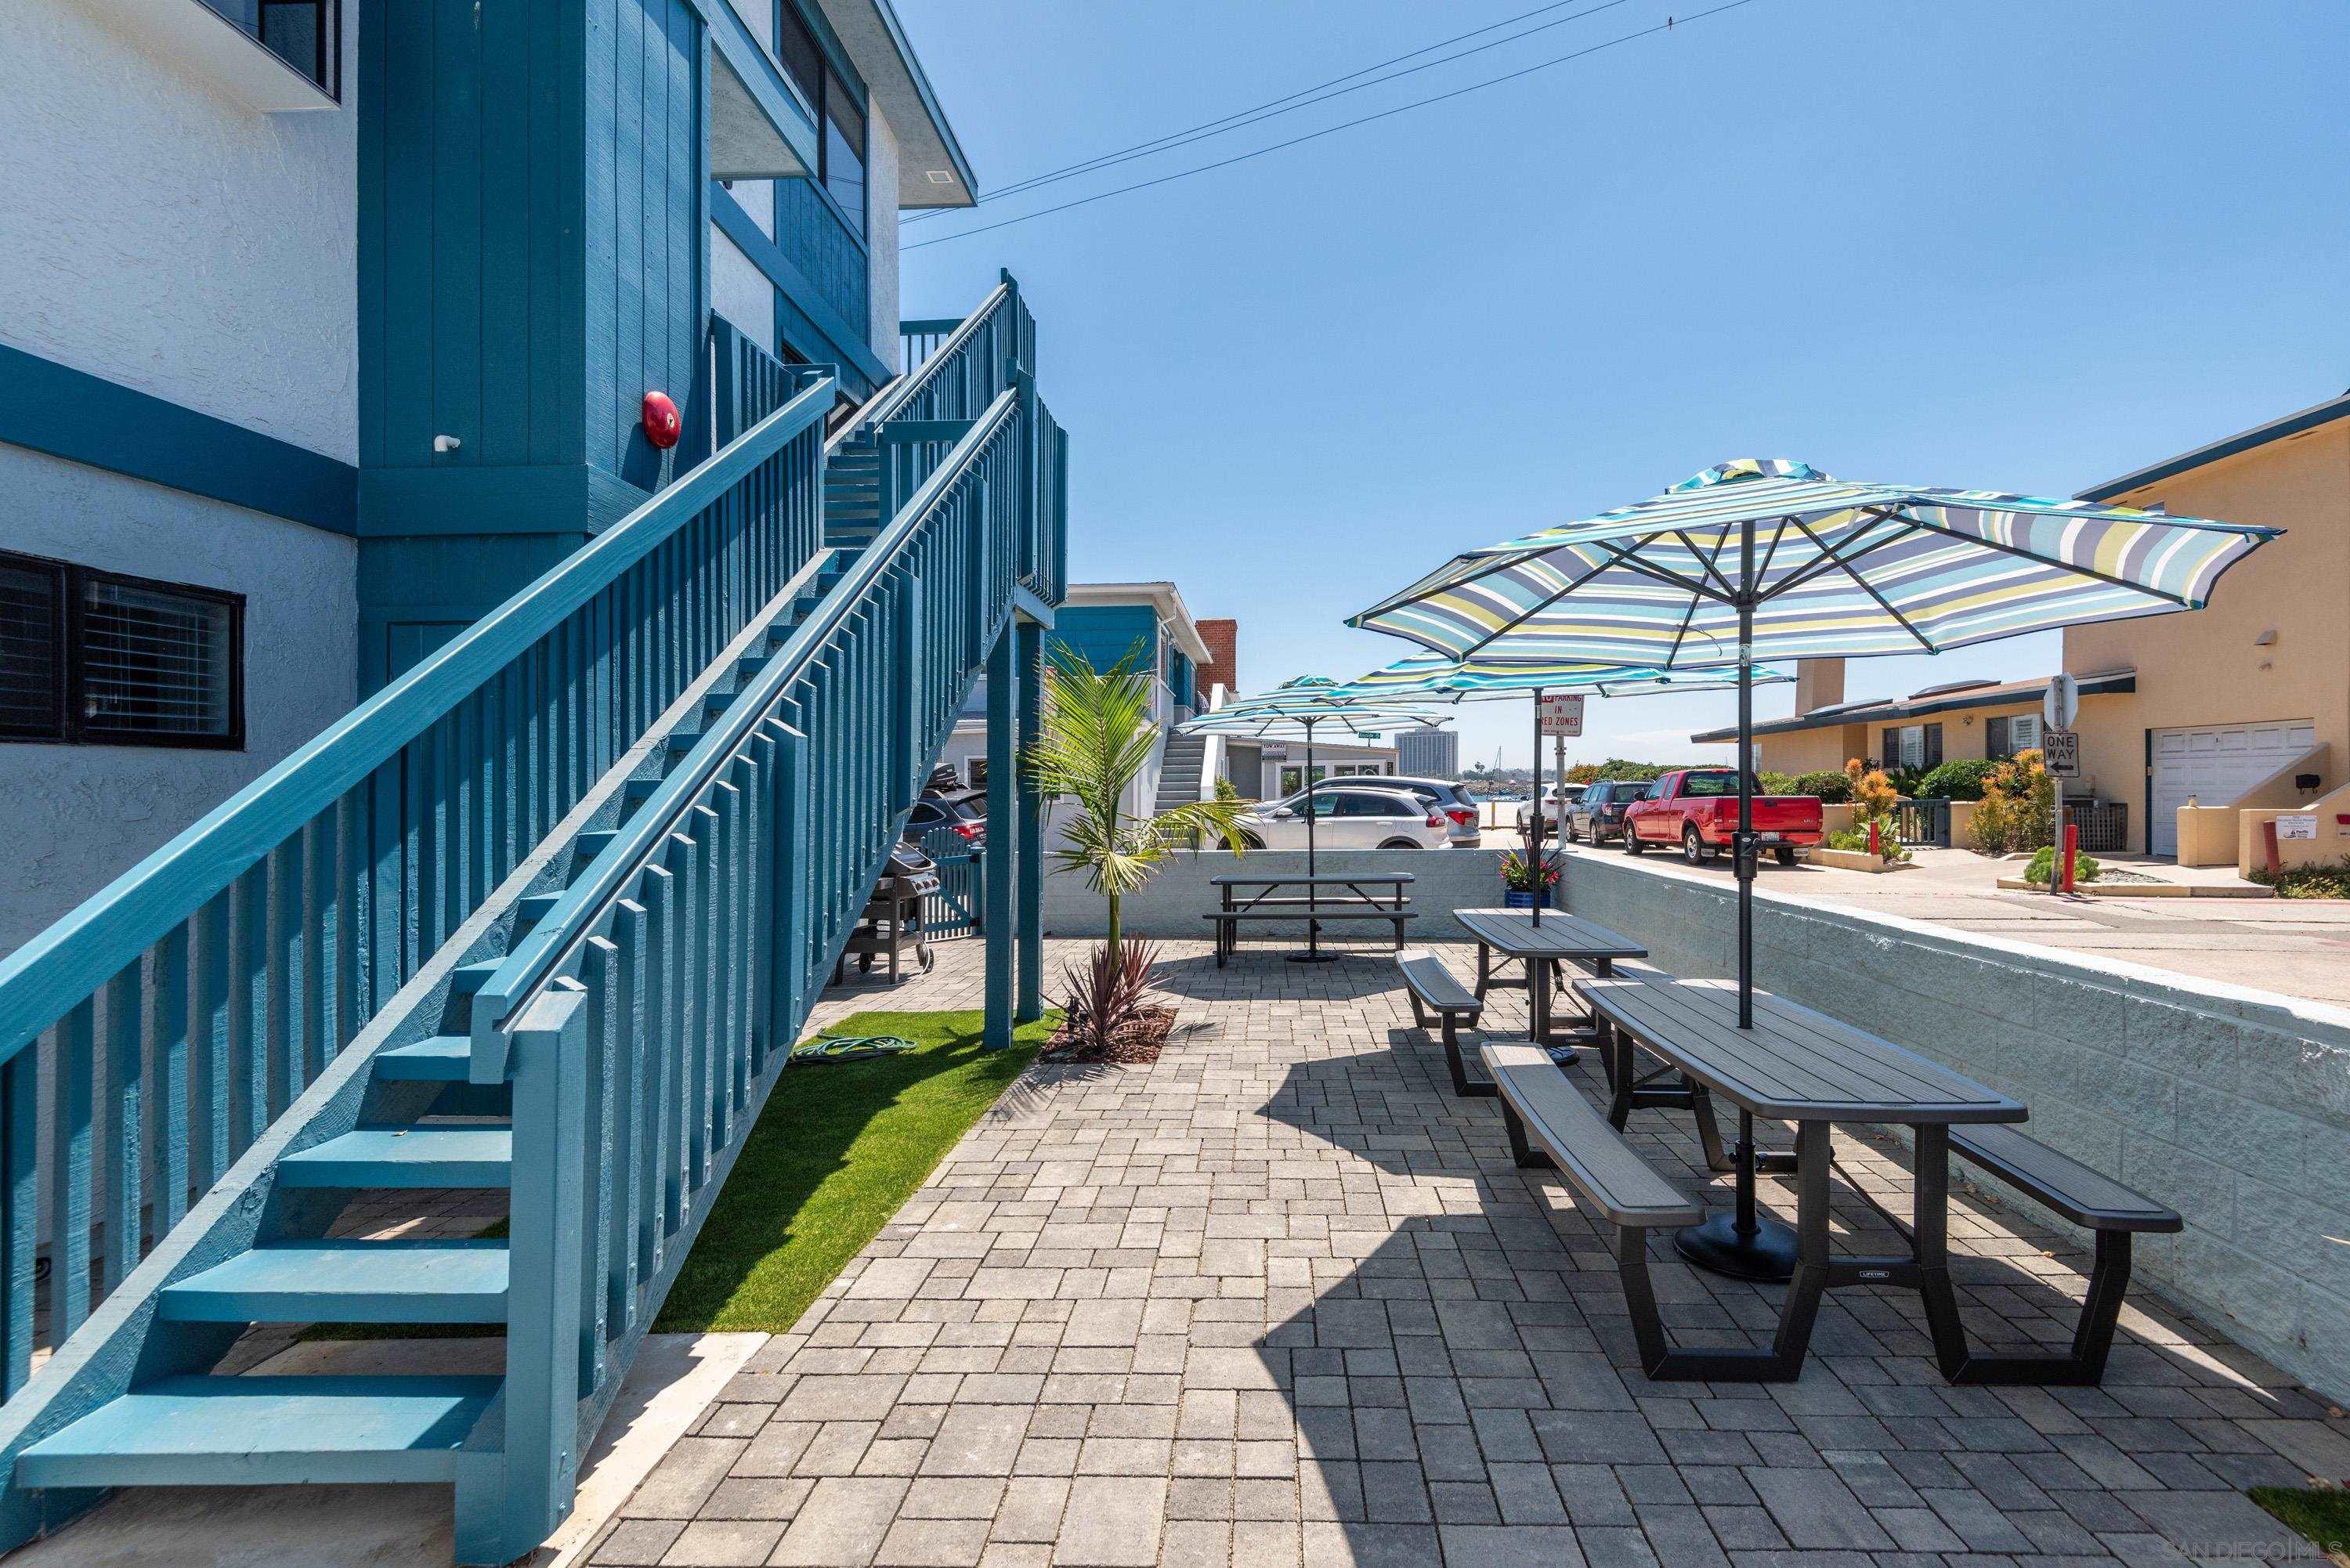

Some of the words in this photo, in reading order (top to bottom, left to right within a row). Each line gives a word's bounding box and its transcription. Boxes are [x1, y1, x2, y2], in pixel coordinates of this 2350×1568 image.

[1554, 705, 1562, 714] IN
[1556, 717, 1578, 726] ZONES
[2048, 736, 2074, 746] ONE
[2047, 749, 2074, 759] WAY
